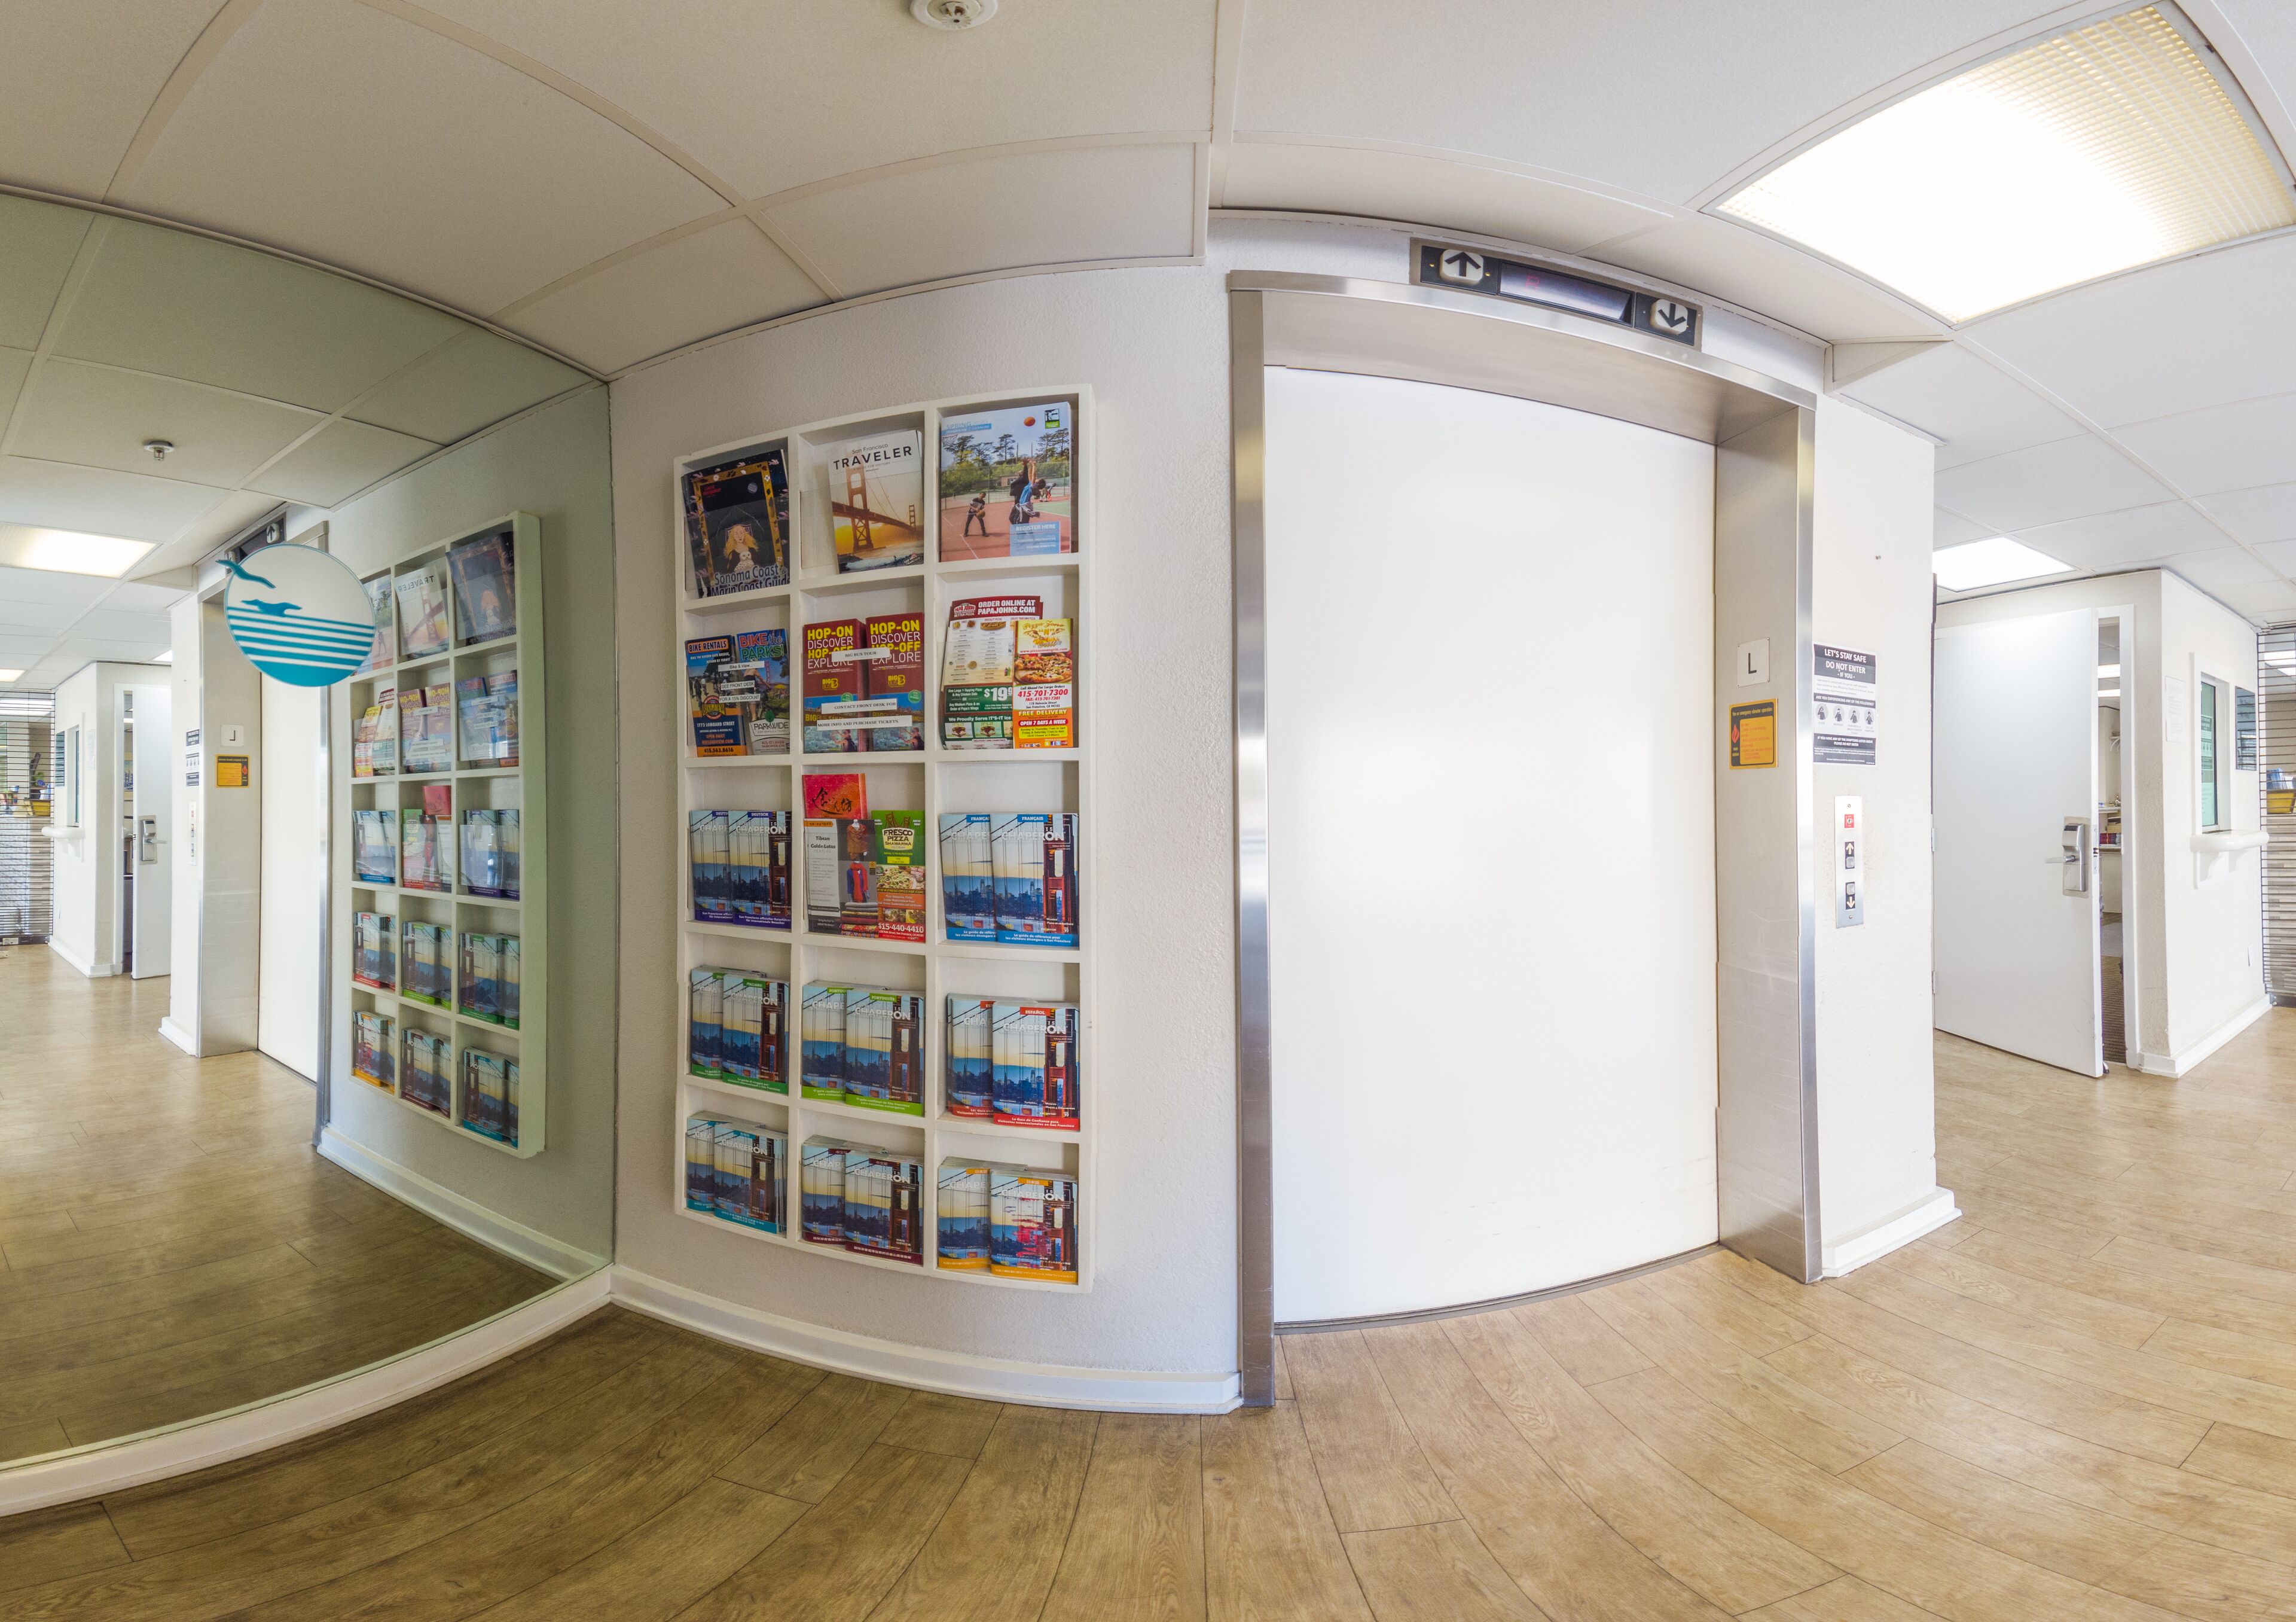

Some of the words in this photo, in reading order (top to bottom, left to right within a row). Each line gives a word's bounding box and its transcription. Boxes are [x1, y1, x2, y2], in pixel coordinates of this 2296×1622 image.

[863, 443, 889, 452] Francisco
[833, 446, 912, 470] TRAVELER
[715, 569, 750, 586] Sonoma
[752, 564, 779, 578] Coast
[712, 584, 736, 596] Marin
[738, 580, 763, 592] Coast
[978, 606, 1036, 615] PAPAJOHNS.COM
[807, 625, 853, 641] HOP-ON
[870, 620, 920, 635] HOP-ON
[739, 633, 768, 648] BIKE
[768, 632, 783, 645] the
[808, 636, 854, 650] DISCOVER
[871, 632, 921, 644] DISCOVER
[689, 644, 702, 652] BIKE
[703, 641, 727, 650] RENTALS
[741, 644, 785, 661] PARKS!
[1824, 648, 1839, 658] LET'S
[1840, 652, 1852, 660] STAY
[1853, 654, 1867, 663] SAFE
[1748, 653, 1757, 674] L
[1849, 664, 1866, 674] ENTER
[754, 722, 789, 730] PARKWIDE
[735, 825, 786, 834] CHAPERON
[1002, 831, 1065, 842] CHAPERON
[731, 992, 778, 1006] CHAPERON
[854, 1007, 911, 1021] CHAPERON
[1003, 1022, 1066, 1035] CHAPERON
[721, 1139, 767, 1155] CHAPERON
[854, 1168, 910, 1184] CHAPERON
[1001, 1189, 1064, 1202] CHAPERON
